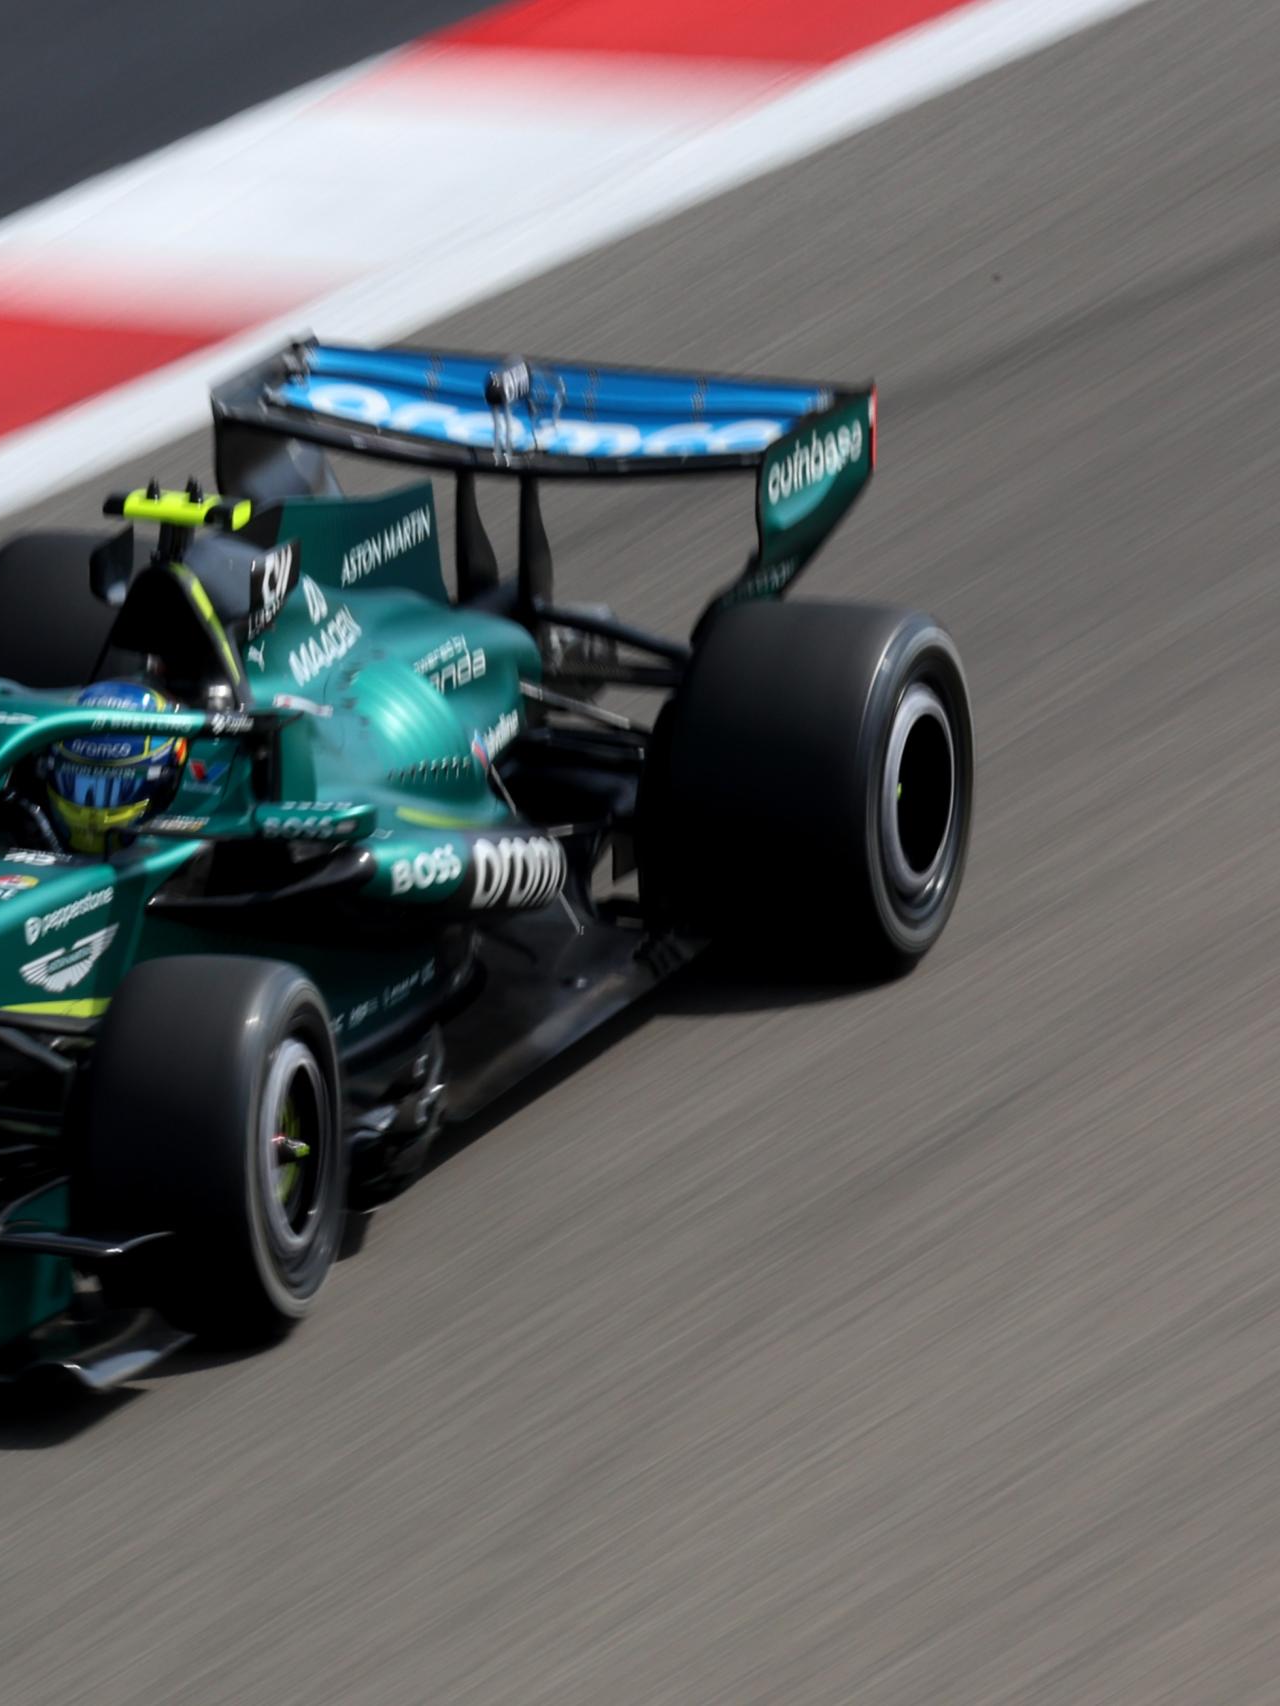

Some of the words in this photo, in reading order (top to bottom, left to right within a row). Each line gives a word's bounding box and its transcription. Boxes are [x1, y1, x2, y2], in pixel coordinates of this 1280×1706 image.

[341, 532, 382, 588] ASTON
[384, 503, 431, 563] MARTIN
[391, 843, 462, 895] BOSS
